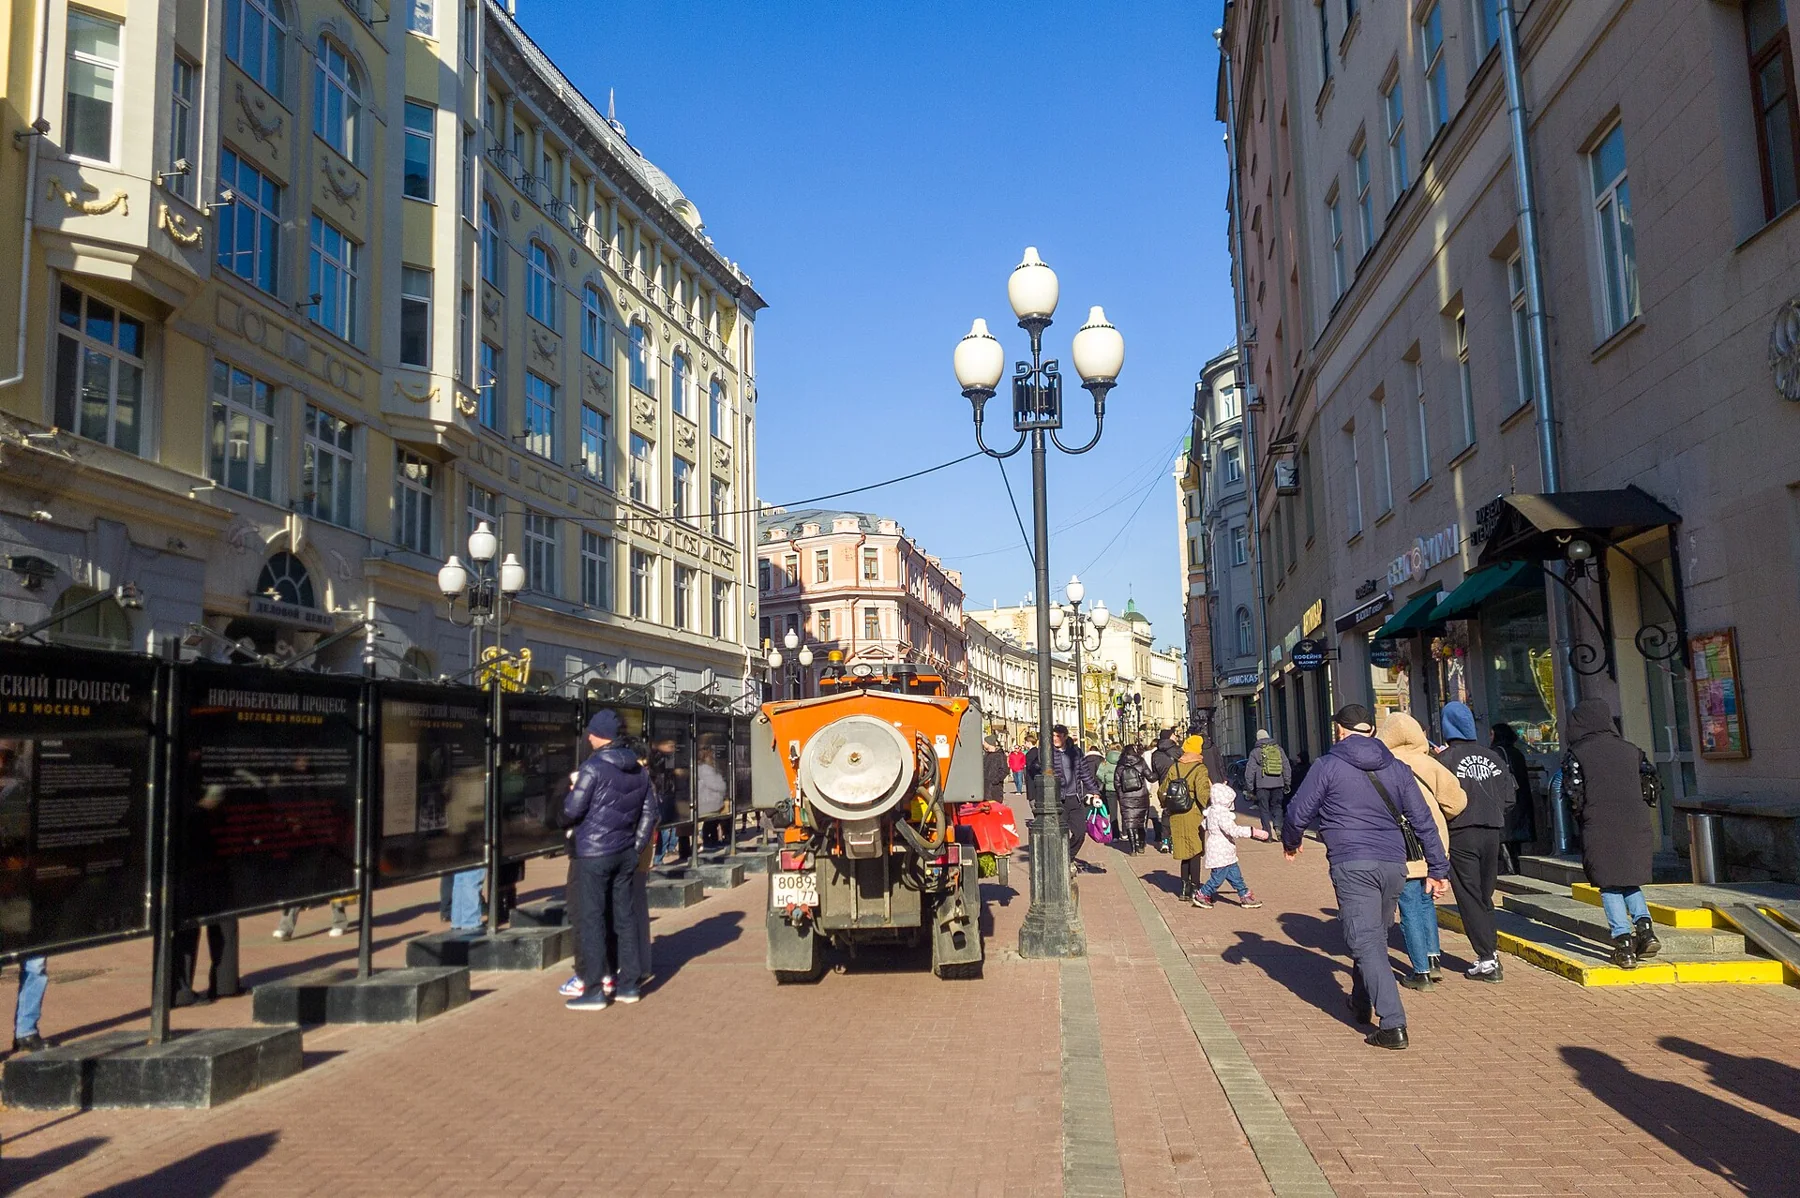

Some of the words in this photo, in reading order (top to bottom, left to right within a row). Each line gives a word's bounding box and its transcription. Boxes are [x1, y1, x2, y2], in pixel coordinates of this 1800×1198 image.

[256, 602, 299, 619] ДЕЛОВОЙ
[305, 611, 333, 626] ЦЕНТР
[1294, 652, 1322, 660] КОФЕЙНЯ
[56, 678, 130, 704] ПРОЦЕСС
[208, 687, 299, 711] НЮРНБЕРГСКИЙ
[302, 695, 347, 714] ПРОЦЕСС
[8, 702, 26, 713] ИЗ
[33, 703, 91, 716] МОСКВЫ
[237, 711, 272, 724] ВЗГЛЯД
[275, 713, 286, 723] ИЗ
[289, 714, 323, 725] МОСКВЫ
[1457, 755, 1502, 778] ПИТЕРСКИЙ
[778, 876, 812, 889] 8089
[801, 890, 814, 901] 77
